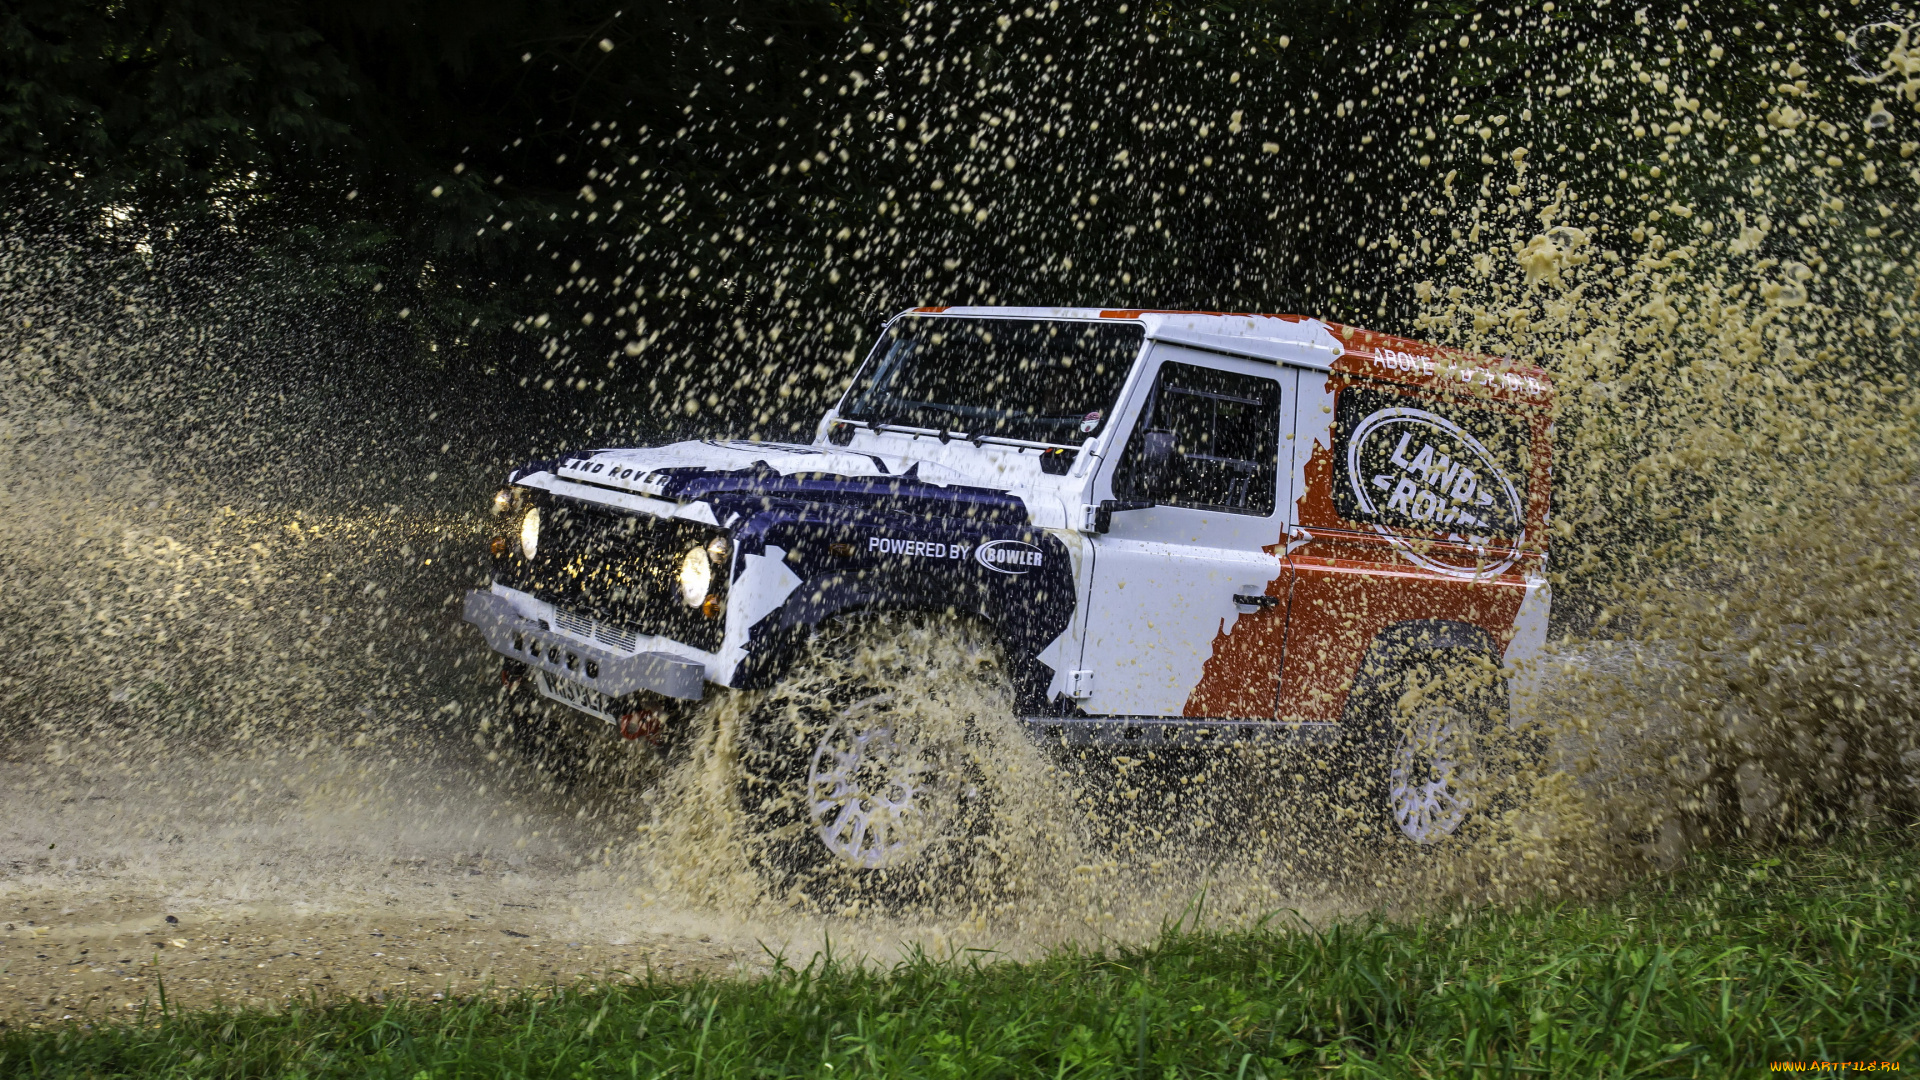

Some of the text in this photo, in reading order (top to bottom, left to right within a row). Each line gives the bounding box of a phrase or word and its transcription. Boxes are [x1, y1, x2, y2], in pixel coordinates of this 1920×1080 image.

[1373, 348, 1434, 376] ABOVE
[607, 466, 673, 487] ROVER
[1390, 430, 1477, 503] LAND
[868, 536, 971, 560] POWERED BY
[986, 547, 1043, 567] BOWLER
